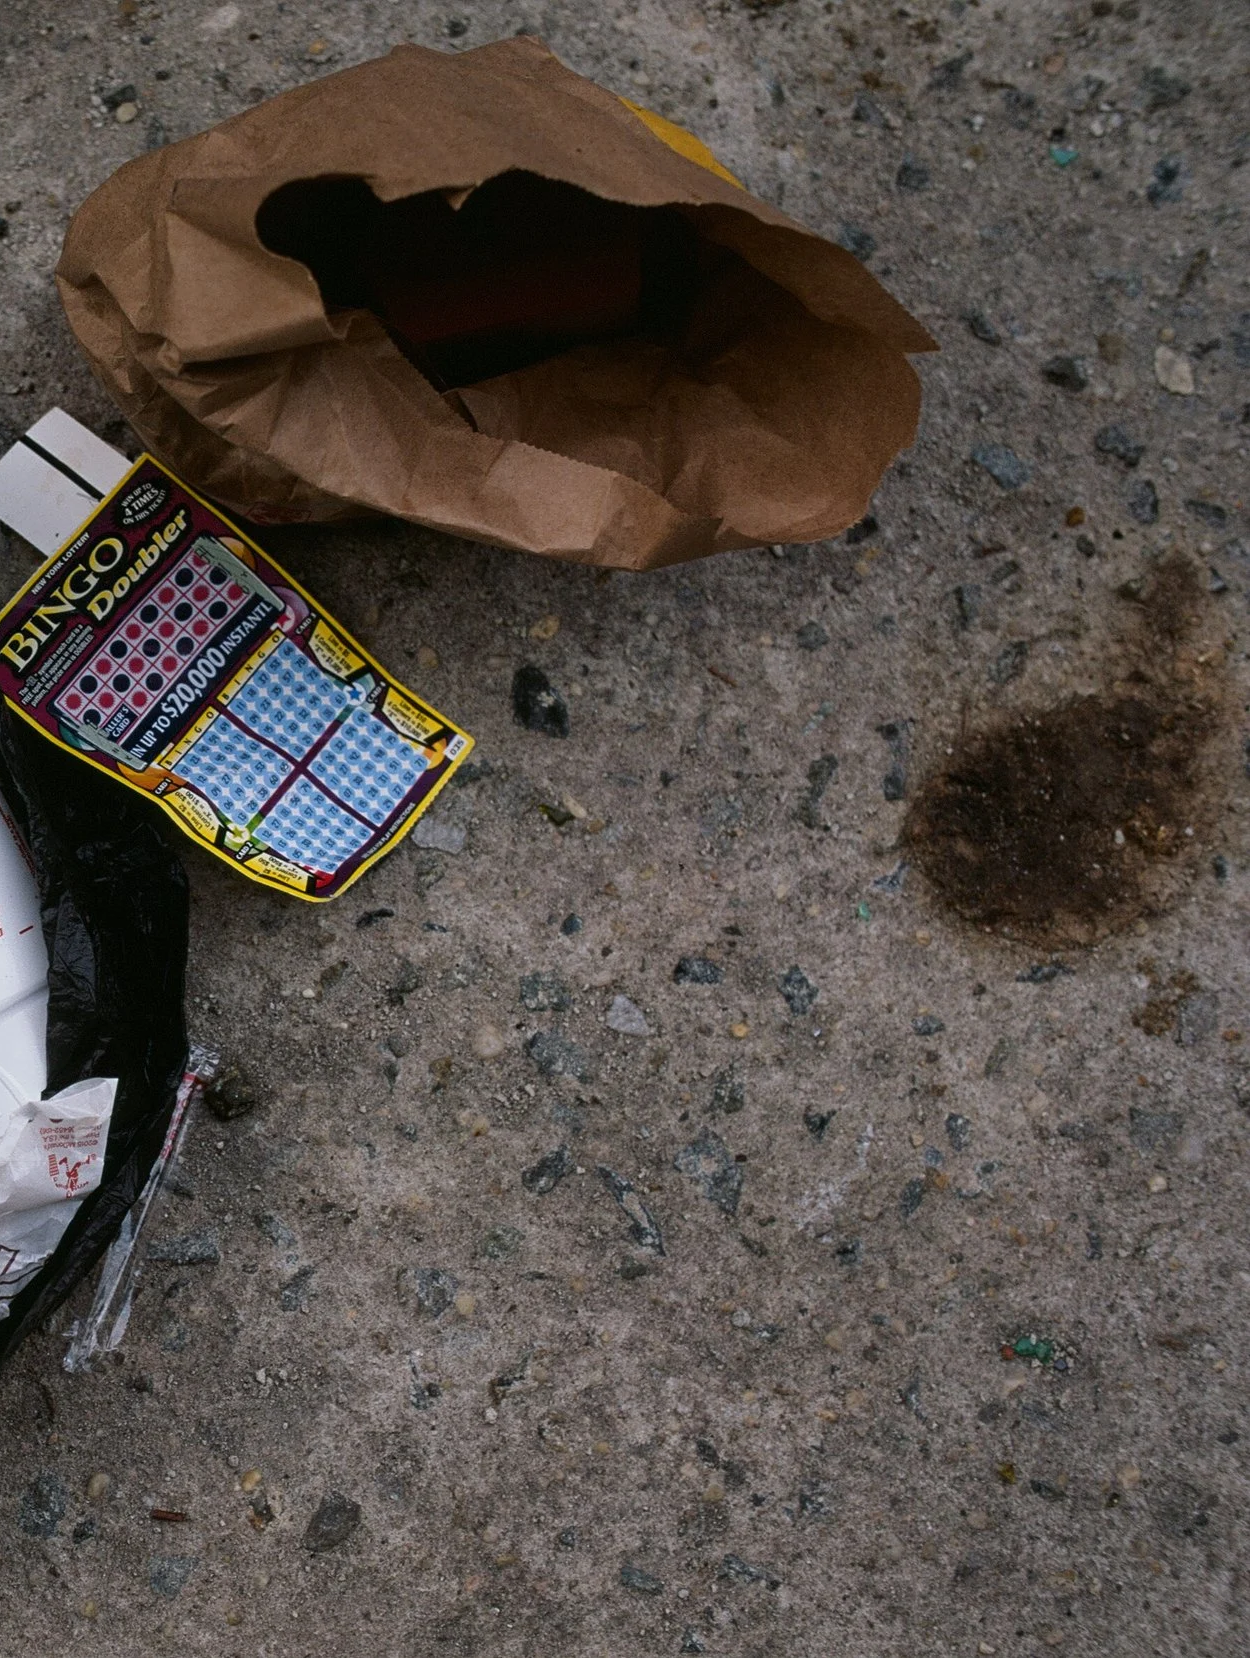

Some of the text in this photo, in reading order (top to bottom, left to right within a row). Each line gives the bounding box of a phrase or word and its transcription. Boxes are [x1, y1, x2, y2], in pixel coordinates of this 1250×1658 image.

[121, 482, 151, 506] WIN UP TO
[124, 484, 158, 516] 4 TIMES
[122, 513, 134, 524] ON
[134, 510, 149, 520] THIS
[31, 532, 89, 594] NEW YORK LOTTERY
[87, 508, 188, 627] Doubler
[295, 617, 311, 634] CARD
[18, 687, 28, 696] The
[37, 657, 53, 675] symbol
[55, 642, 67, 654] each
[65, 631, 75, 643] card
[21, 691, 33, 704] FREE
[48, 656, 65, 674] appears
[51, 669, 63, 682] prize
[130, 601, 273, 759] IN UP TO $20,000 INSTANTL
[367, 686, 381, 701] CARD
[105, 706, 128, 733] ALLER'S
[112, 718, 129, 736] CARD
[154, 781, 167, 794] CARD
[174, 791, 186, 801] $20
[185, 791, 199, 805] $100
[178, 803, 202, 829] Line $2
[190, 805, 210, 827] Corners
[235, 845, 249, 859] CARD
[275, 865, 297, 878] Corners
